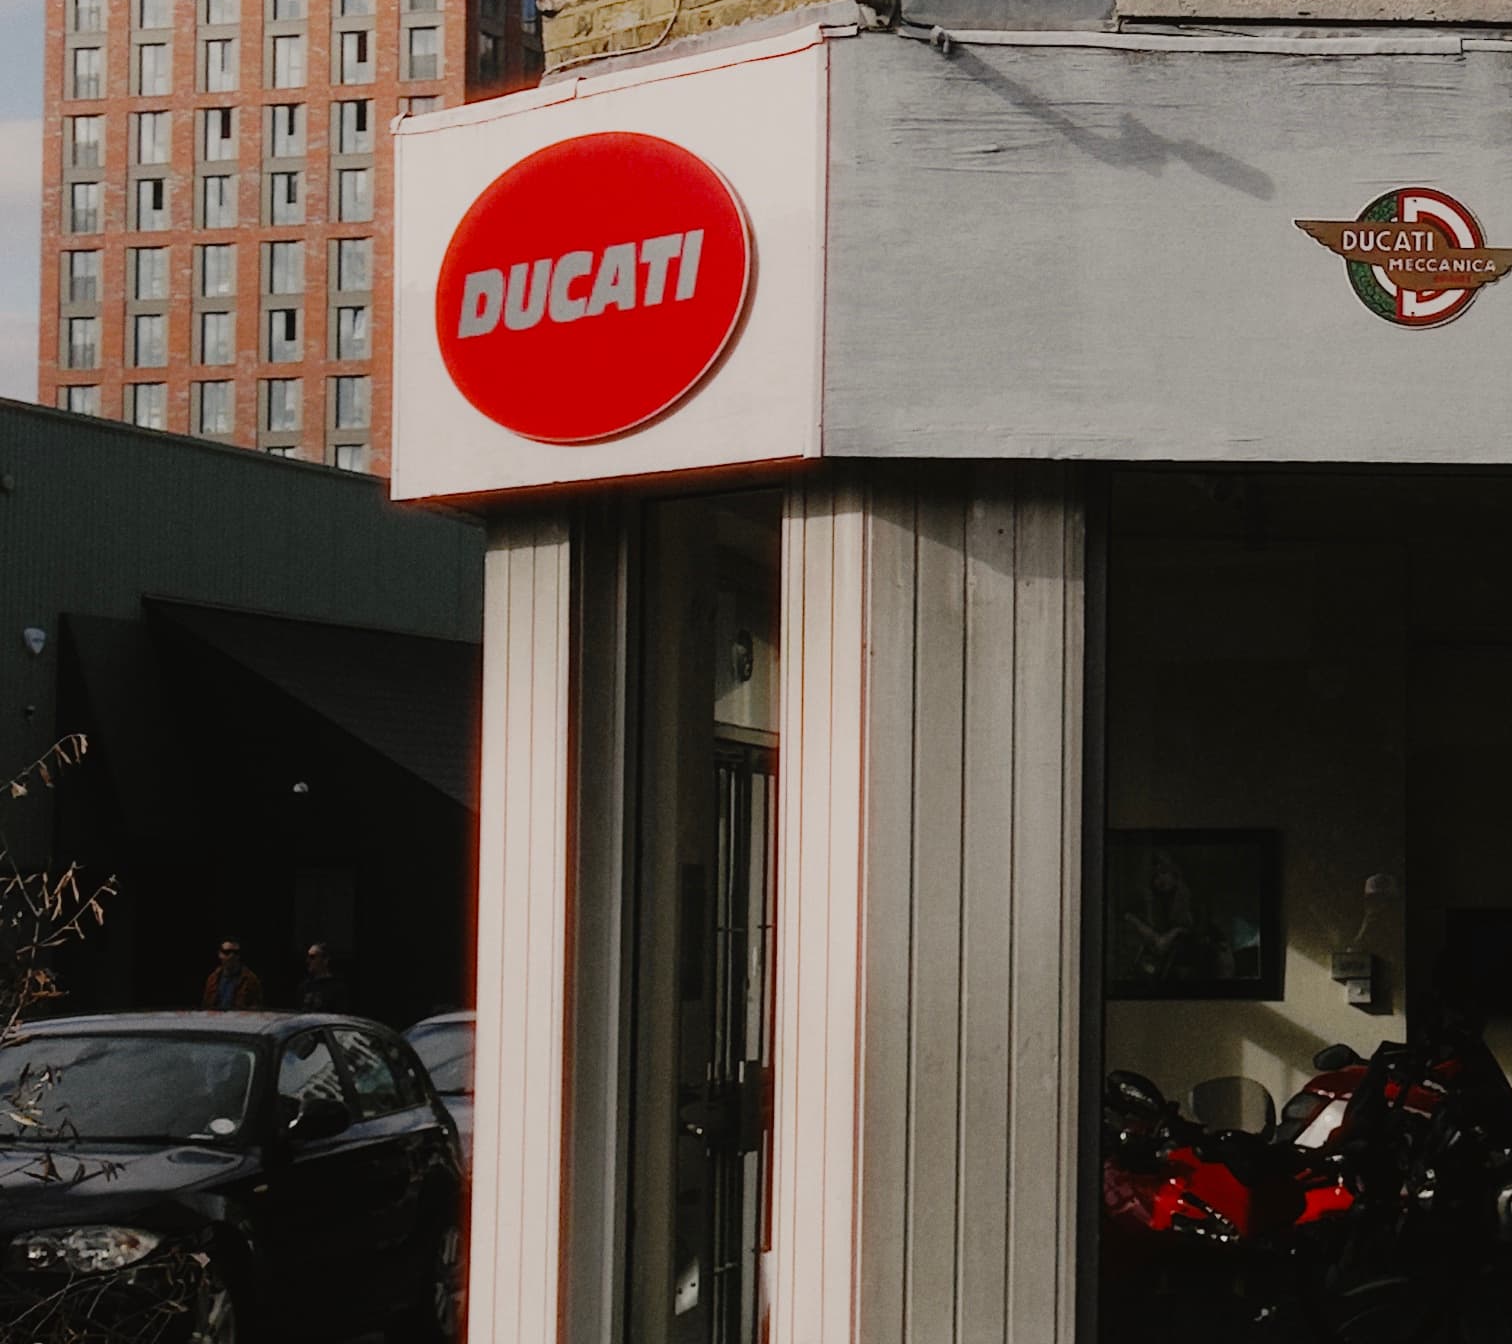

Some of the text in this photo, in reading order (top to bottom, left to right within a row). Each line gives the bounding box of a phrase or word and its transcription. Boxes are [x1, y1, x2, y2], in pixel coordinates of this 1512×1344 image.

[1342, 230, 1434, 252] DUCATI
[1388, 257, 1497, 273] MECCANICA
[457, 228, 705, 340] DUCATI
